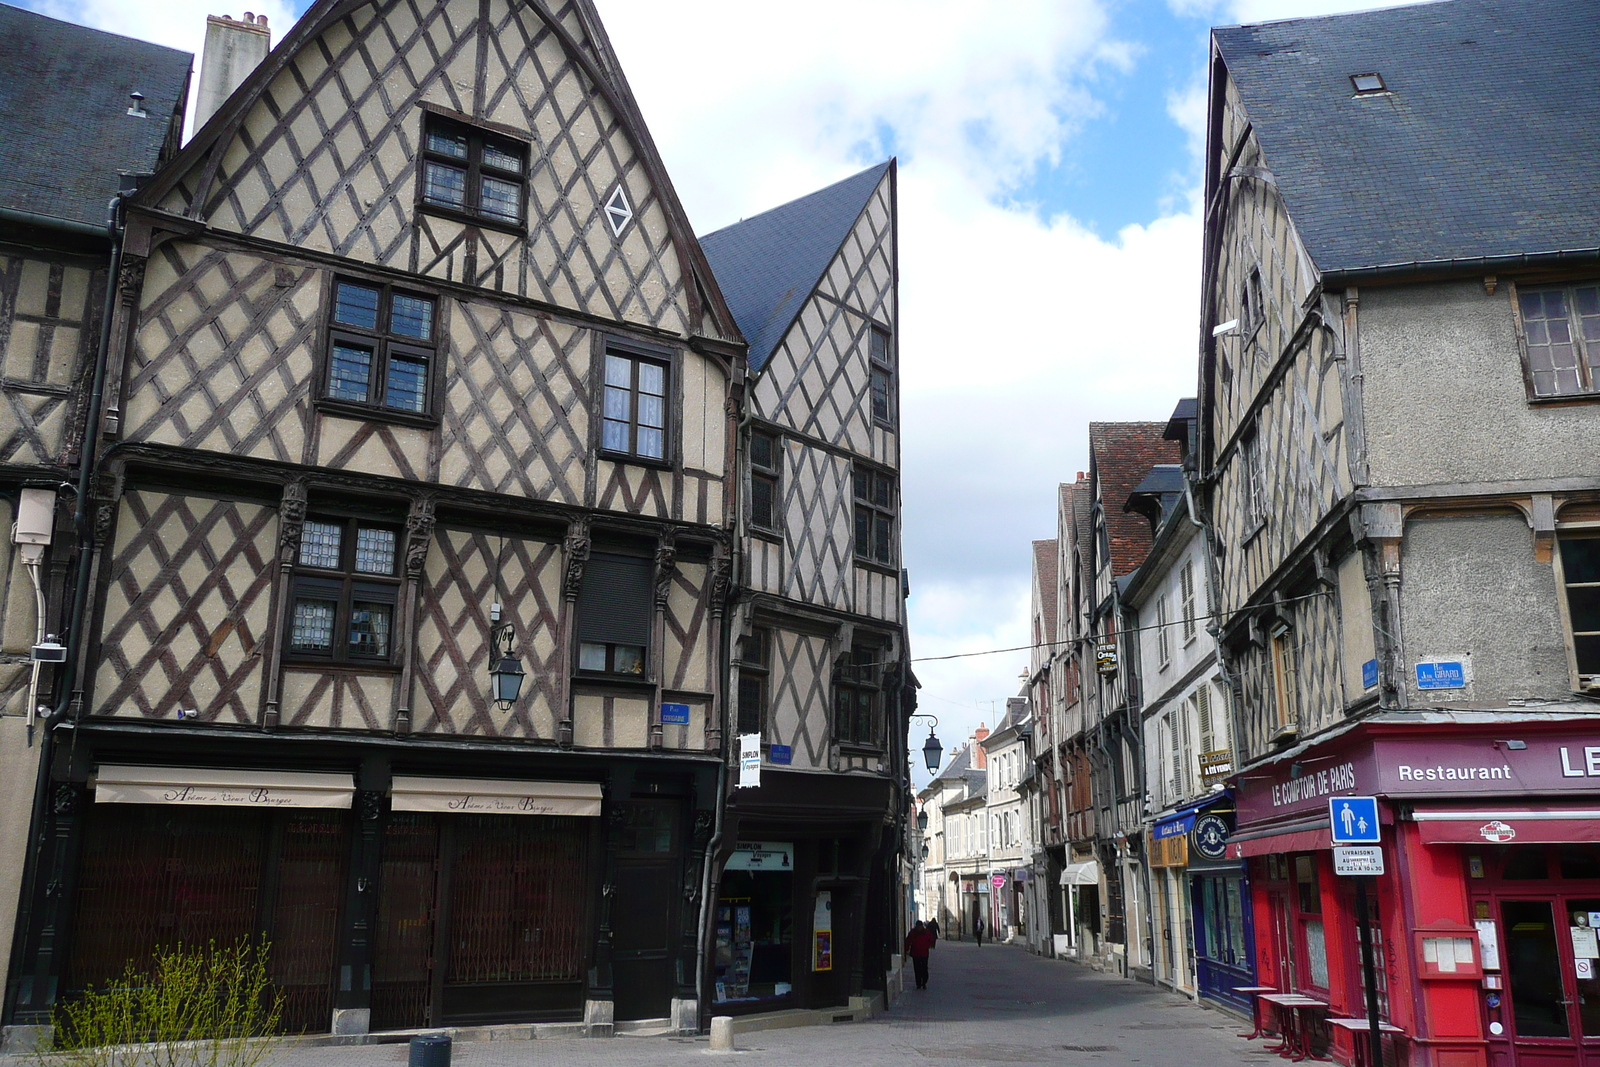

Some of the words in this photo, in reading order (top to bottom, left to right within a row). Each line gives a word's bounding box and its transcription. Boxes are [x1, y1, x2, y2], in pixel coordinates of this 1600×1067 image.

[1434, 670, 1459, 678] GIRARD
[742, 750, 759, 759] SIMPLON
[1560, 747, 1600, 777] LE
[742, 760, 759, 771] Voyages
[1398, 764, 1512, 781] Restaurant
[1272, 786, 1281, 807] LE
[1282, 775, 1316, 805] COMPTOIR
[1317, 770, 1329, 796] DE
[1330, 762, 1355, 792] PARIS
[249, 788, 294, 805] Bourges
[518, 797, 554, 813] Bourges
